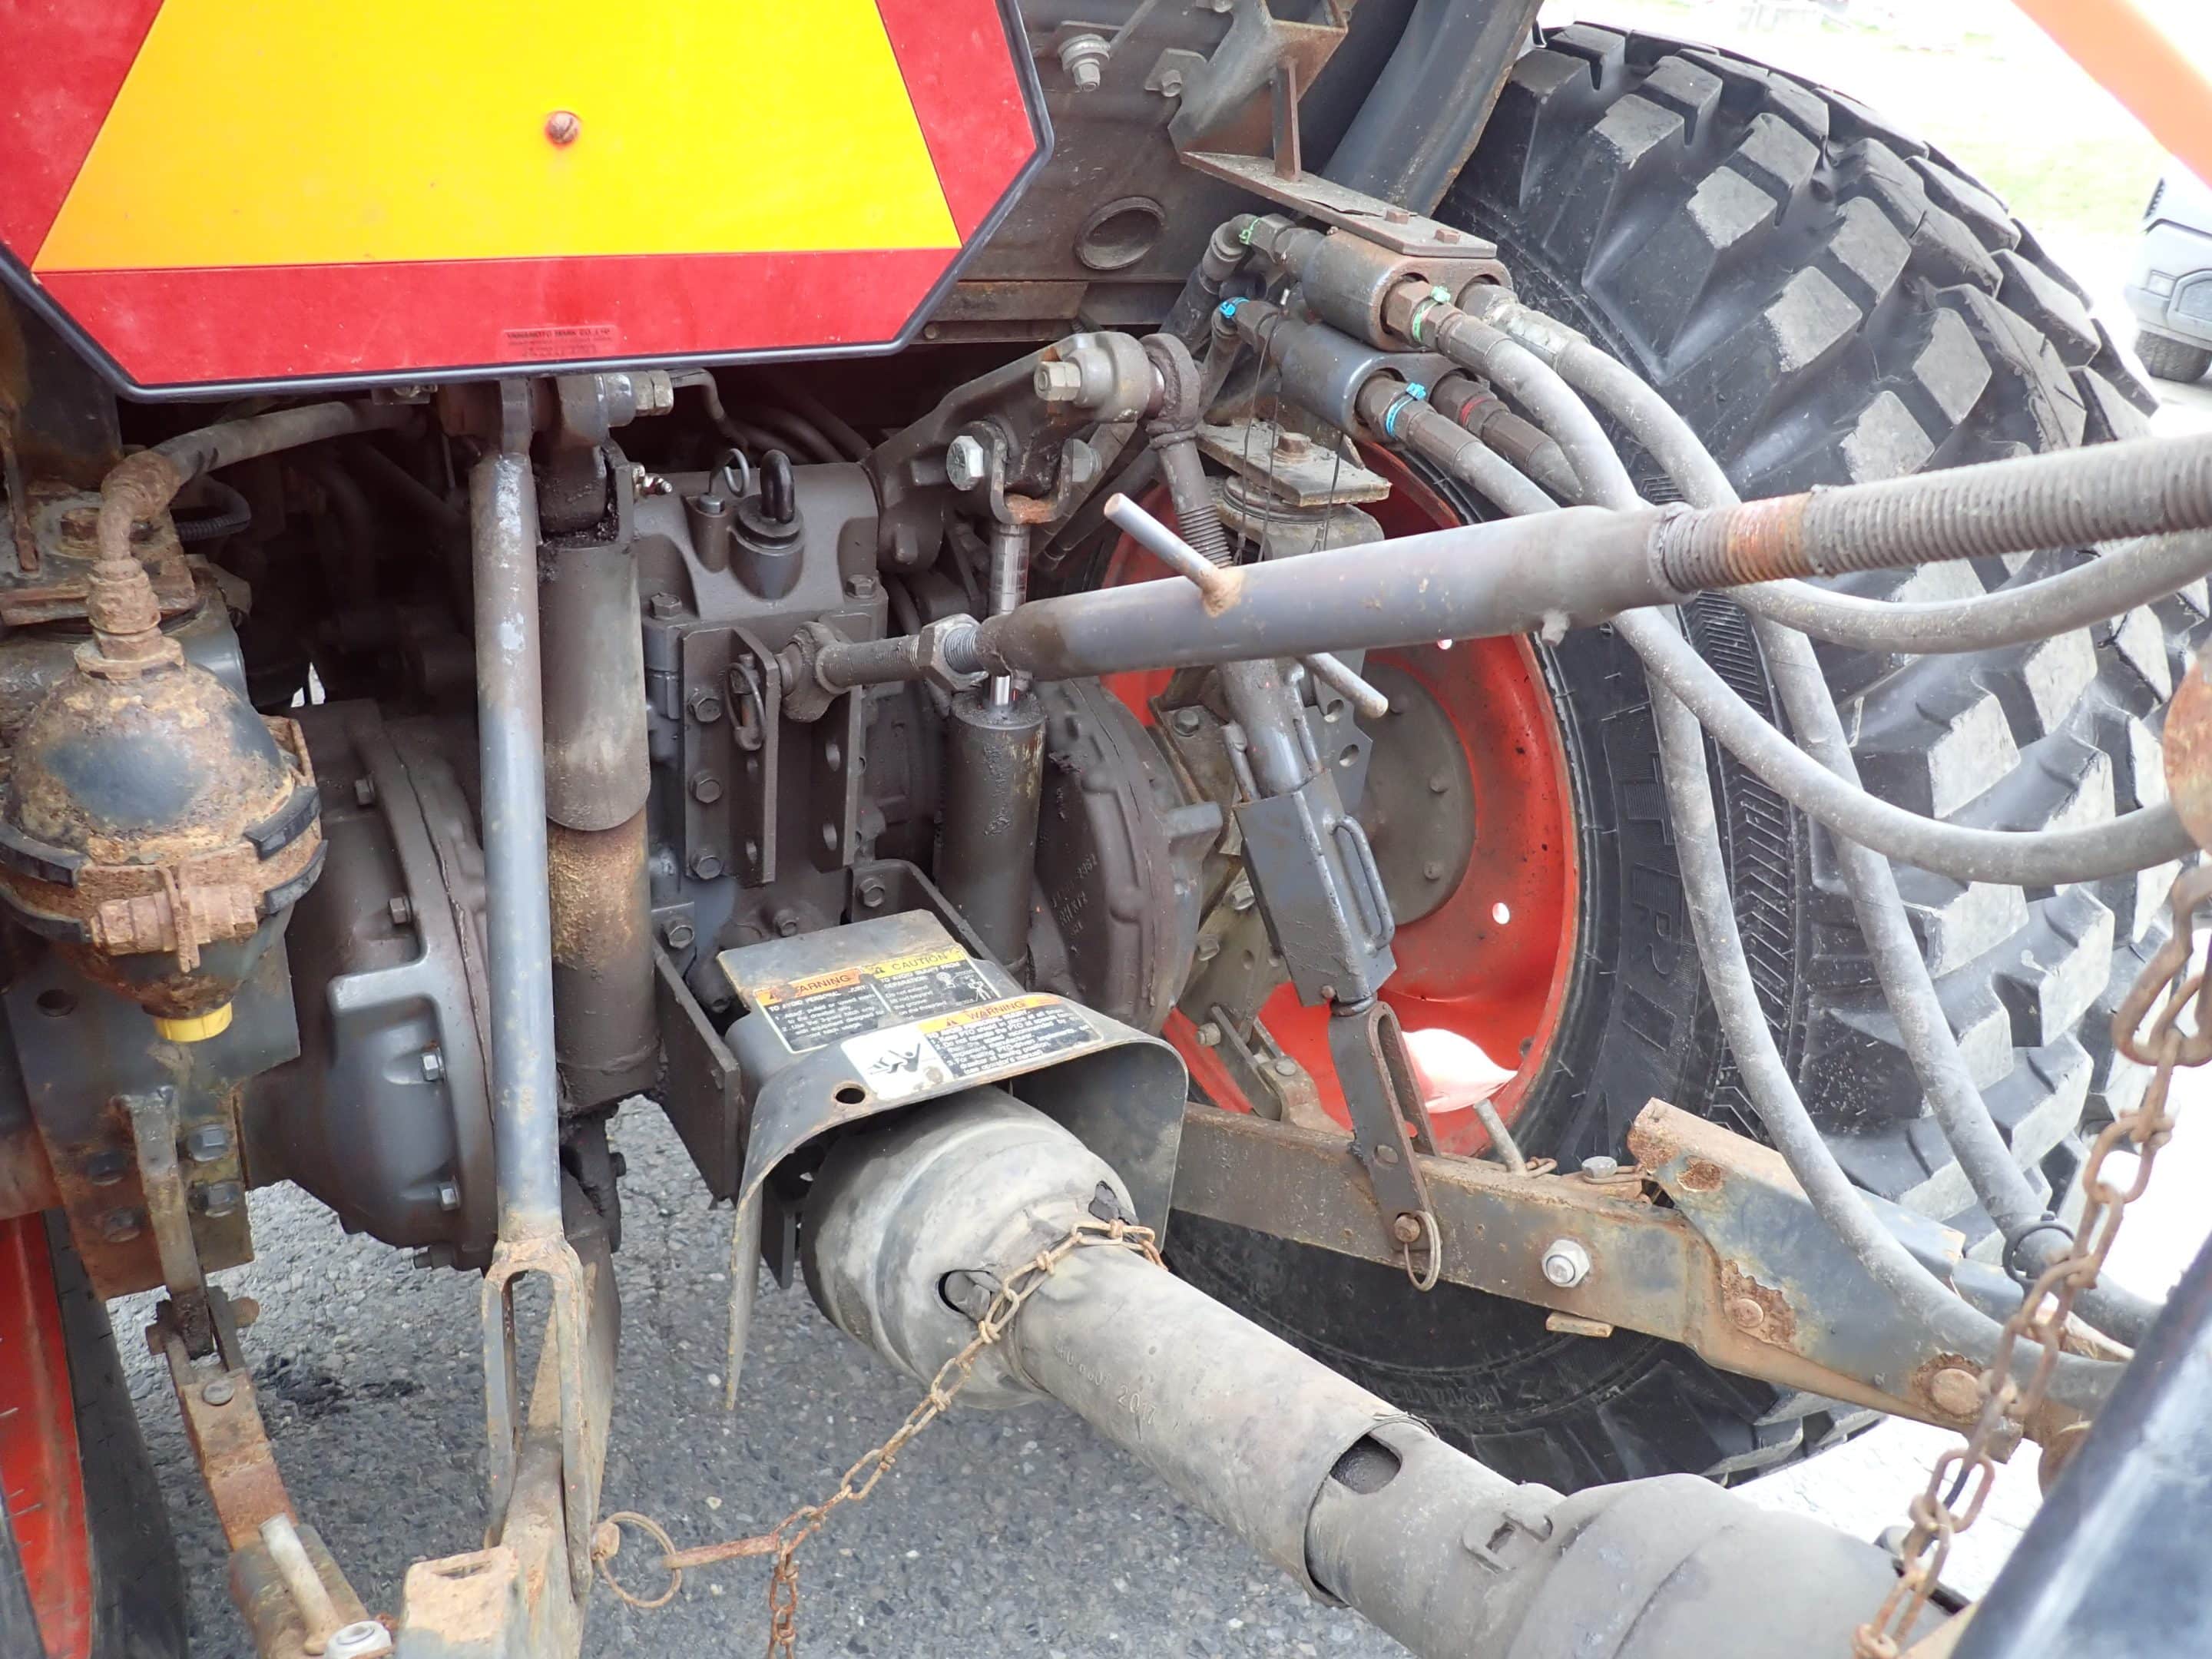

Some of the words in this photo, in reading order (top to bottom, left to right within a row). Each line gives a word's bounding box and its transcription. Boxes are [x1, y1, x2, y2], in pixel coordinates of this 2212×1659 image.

[892, 952, 949, 970] CAUTION
[796, 975, 851, 993] ARNING
[965, 1001, 1025, 1019] WARNING
